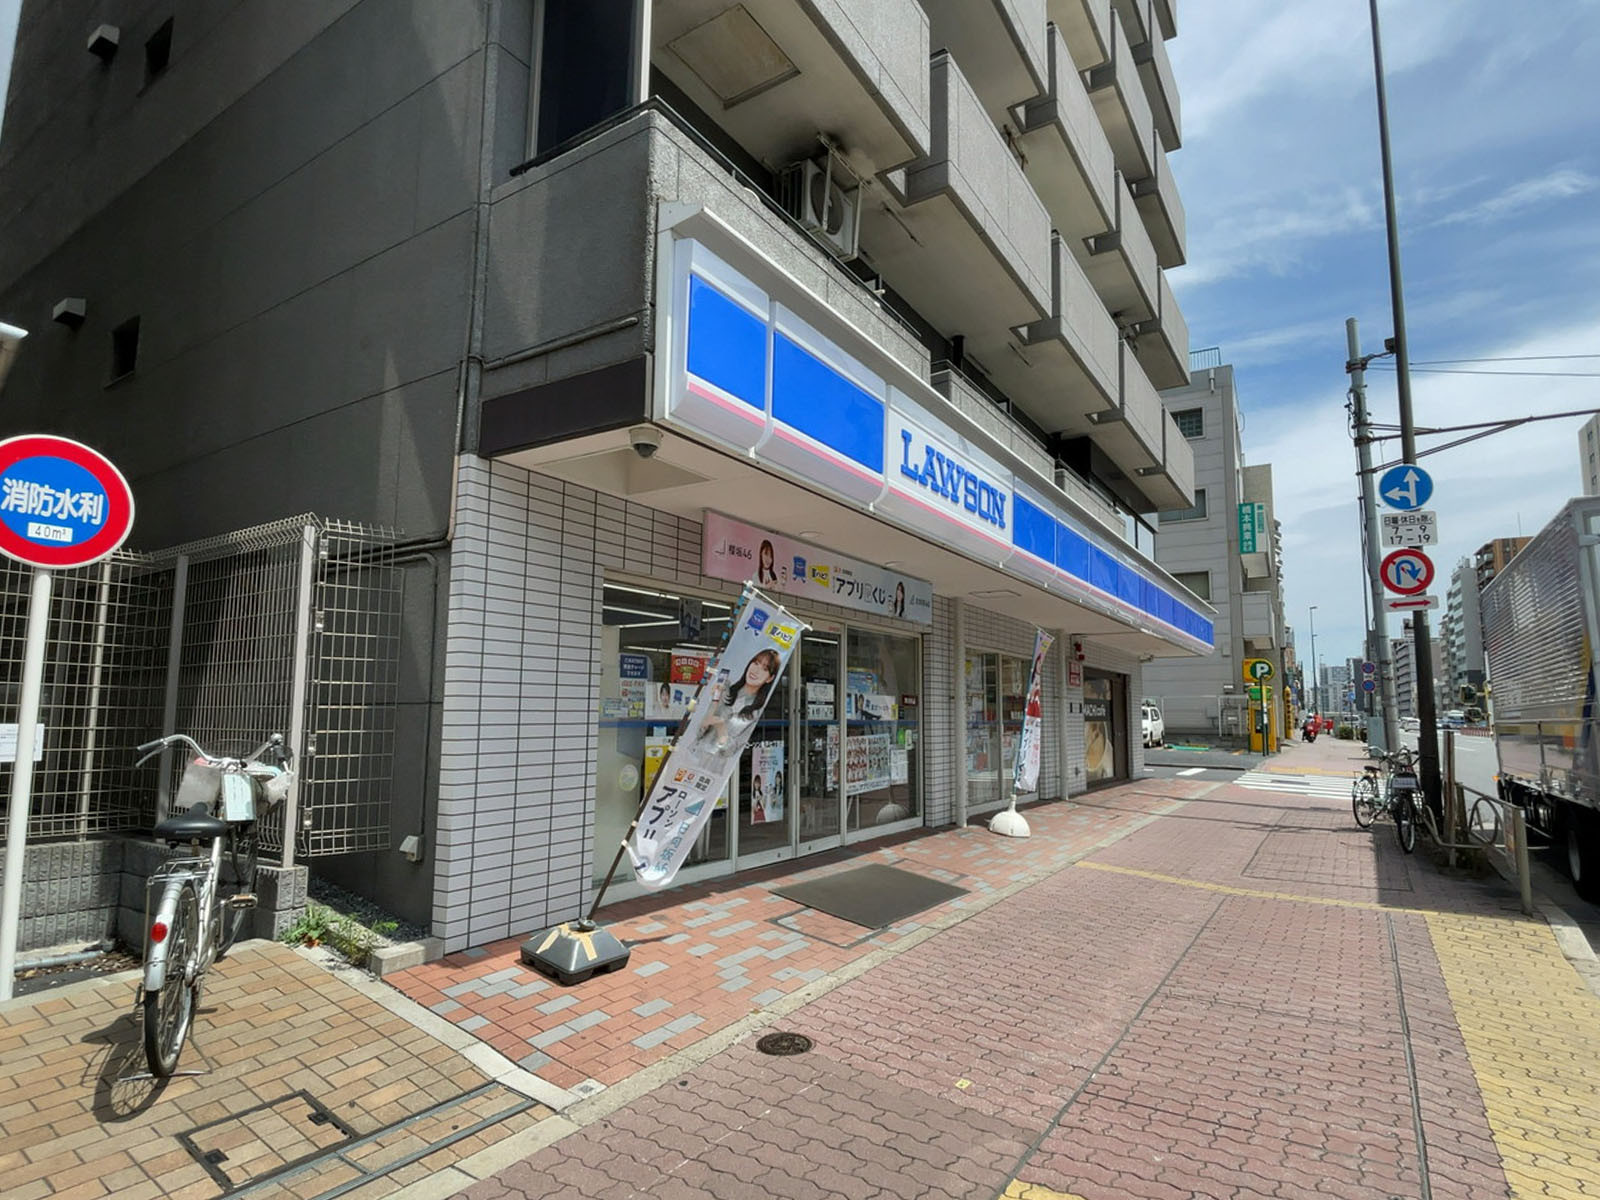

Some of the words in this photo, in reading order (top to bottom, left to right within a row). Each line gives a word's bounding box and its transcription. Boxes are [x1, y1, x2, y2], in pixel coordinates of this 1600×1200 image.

[901, 429, 1006, 529] LAWSON
[1, 478, 104, 525] 消防水利
[1255, 663, 1270, 678] P
[664, 791, 688, 828] ローソン
